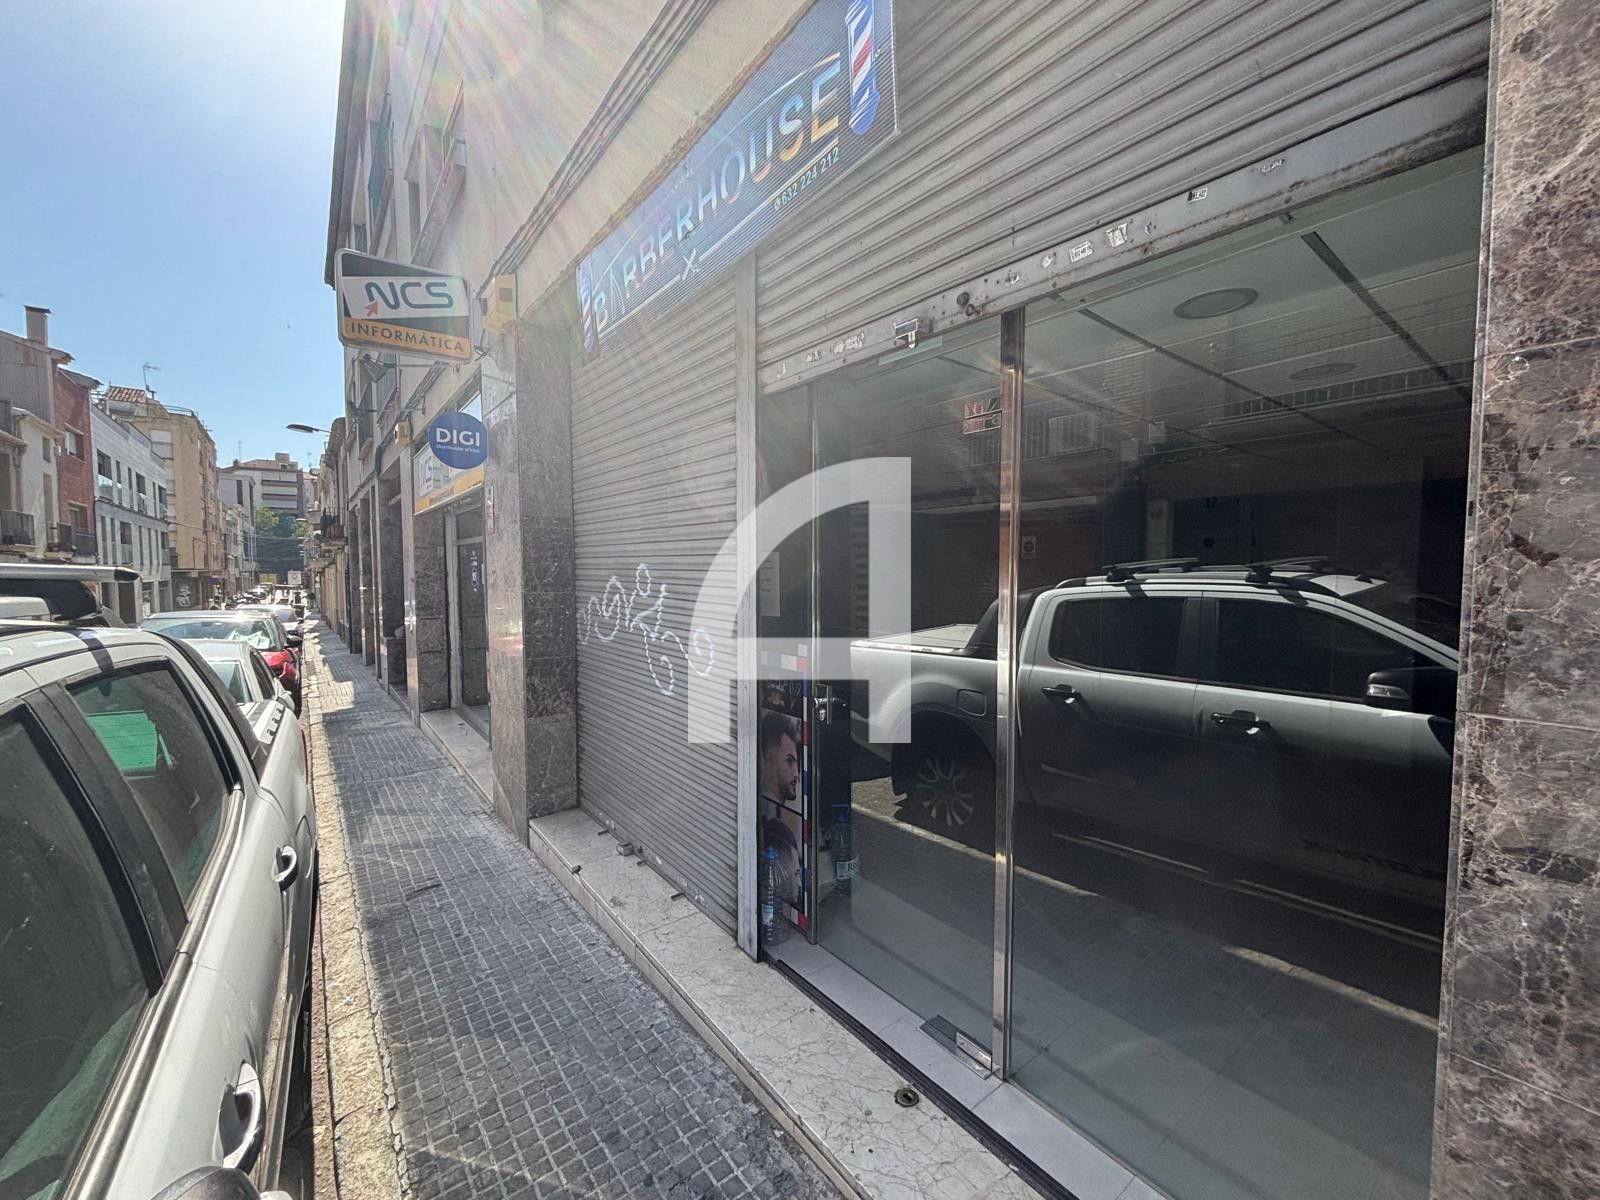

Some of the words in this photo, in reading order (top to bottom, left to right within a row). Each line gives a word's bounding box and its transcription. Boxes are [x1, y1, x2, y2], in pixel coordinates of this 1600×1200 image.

[781, 182, 798, 206] 632
[800, 165, 818, 192] 224
[820, 146, 840, 175] 212
[364, 281, 454, 310] NCS
[351, 322, 463, 352] INFORMÀTICA
[435, 427, 480, 447] DIGI
